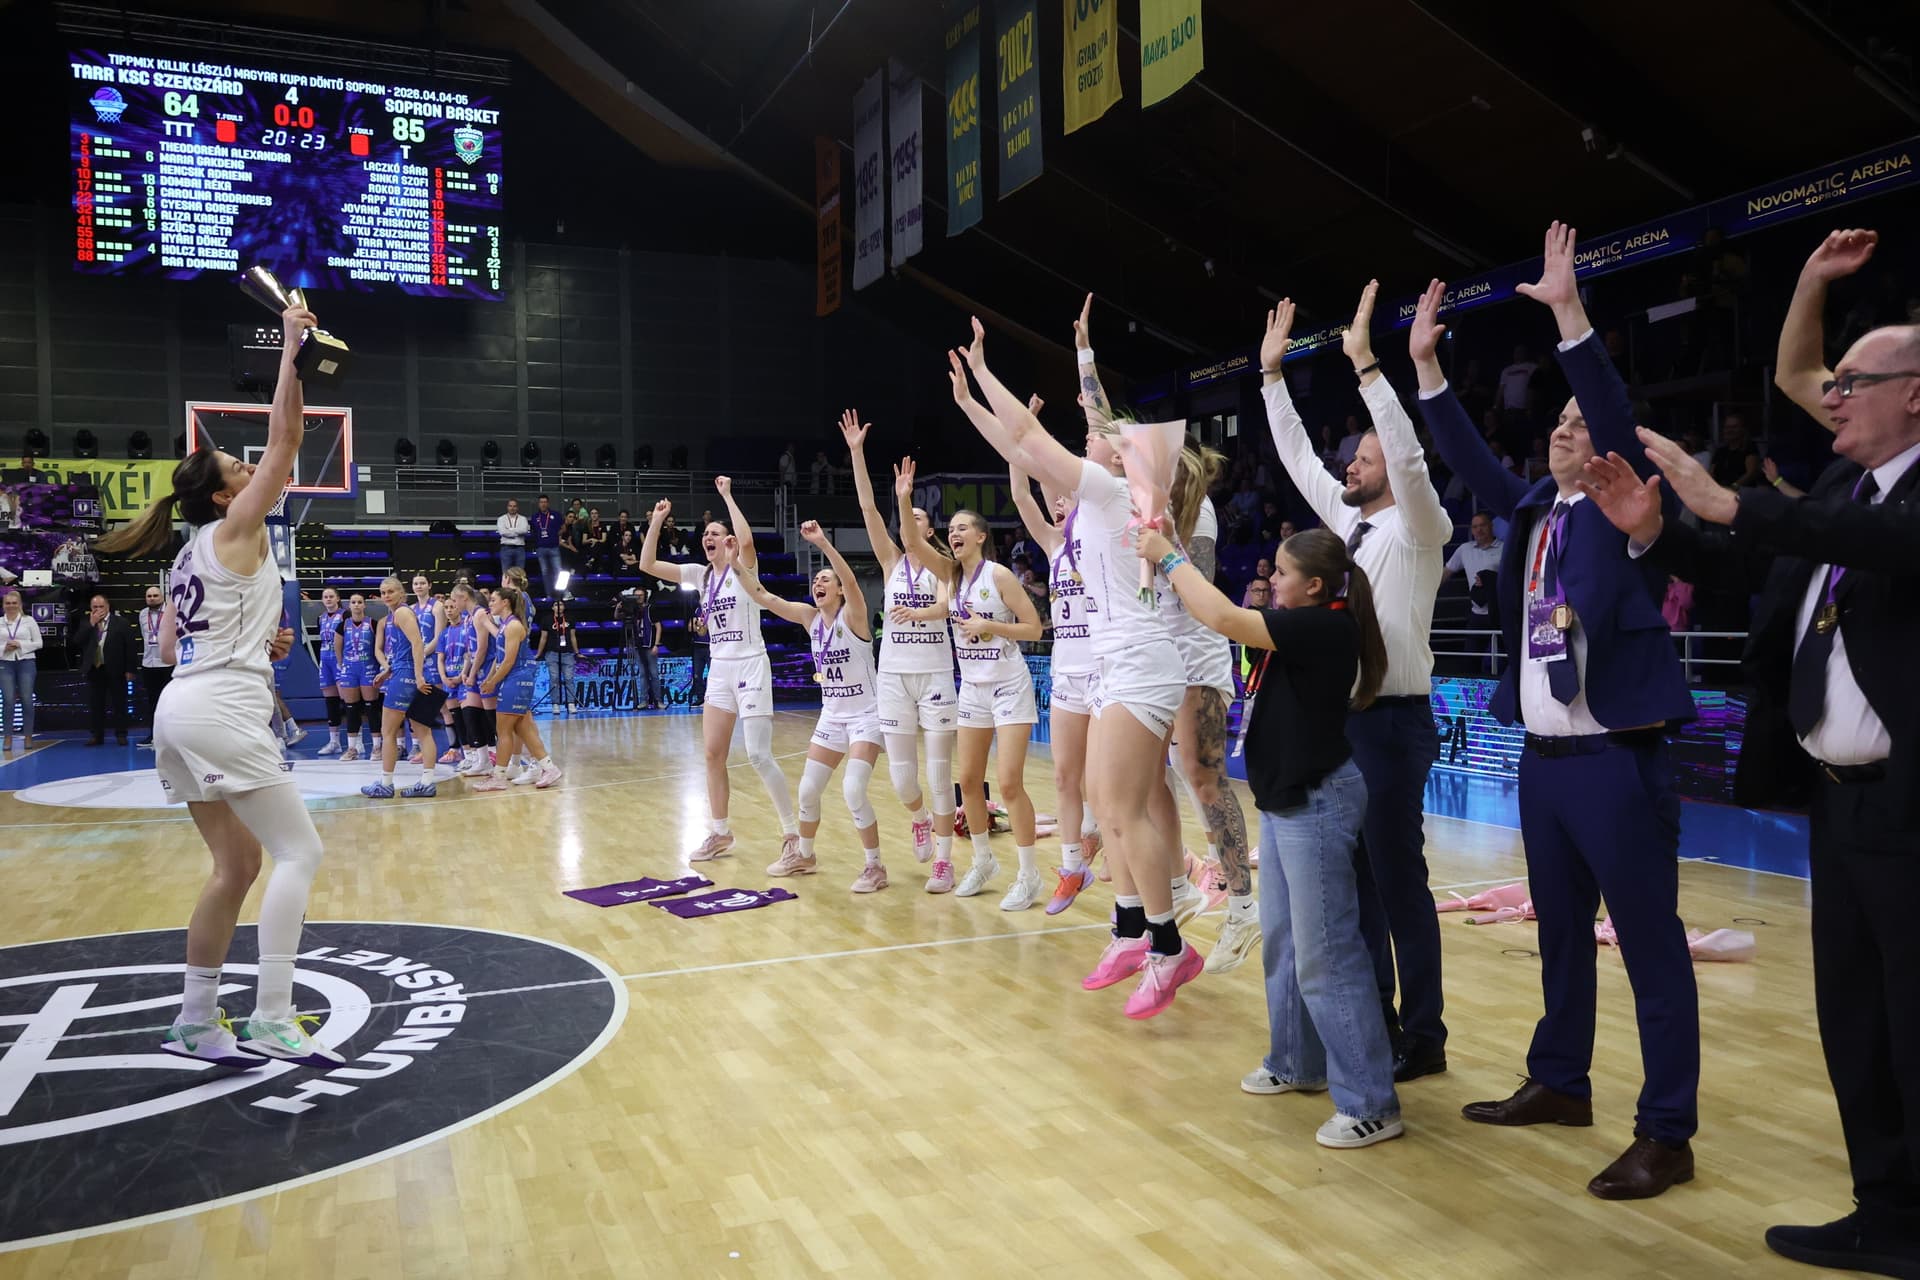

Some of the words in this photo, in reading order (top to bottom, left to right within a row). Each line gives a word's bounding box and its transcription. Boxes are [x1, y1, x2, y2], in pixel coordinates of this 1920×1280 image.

[71, 63, 114, 82] TARR
[119, 69, 149, 86] KSC
[153, 72, 244, 96] SZEKSZÁRD
[108, 53, 154, 69] TIPPMIX
[157, 59, 190, 73] KILLIK
[192, 62, 231, 78] LÁSZLÓ
[234, 68, 278, 83] MAGYAR
[280, 73, 308, 87] KUPA
[310, 76, 343, 91] DÖNTŐ
[345, 81, 385, 96] SOPRON
[164, 91, 199, 118] 64
[285, 86, 299, 105] 4
[274, 104, 314, 129] 0.0
[385, 98, 442, 118] SOPRON
[446, 105, 499, 124] BASKET
[162, 120, 195, 138] TTT
[392, 116, 425, 143] 85
[262, 129, 325, 150] 20:23
[146, 151, 154, 162] 6
[159, 153, 194, 165] MARIA
[231, 148, 291, 163] ALEXANDRA
[400, 145, 411, 160] T
[77, 168, 91, 179] 10
[142, 174, 156, 185] 18
[204, 178, 232, 191] RÉKA
[402, 164, 428, 176] SÁRA
[486, 173, 498, 184] 10
[146, 186, 154, 196] 9
[368, 184, 400, 195] ROKOB
[403, 187, 428, 198] ZORA
[490, 184, 498, 195] 6
[1747, 171, 1845, 215] NOVOMATIC
[1850, 153, 1912, 183] ARÉNA
[146, 197, 155, 208] 6
[361, 194, 386, 204] PAPP
[389, 196, 428, 208] KLAUDIA
[432, 200, 444, 210] 10
[1804, 187, 1847, 206] SOPRON
[142, 208, 156, 220] 16
[350, 214, 374, 226] ZALA
[376, 217, 430, 230] FRISKOVEC
[148, 220, 156, 231] 5
[342, 225, 370, 236] SITKU
[490, 237, 498, 248] 3
[148, 243, 156, 254] 4
[161, 244, 196, 256] HOLCZ
[198, 247, 239, 260] REBEKA
[357, 237, 383, 248] TARA
[386, 240, 430, 252] WALLACK
[491, 248, 498, 258] 6
[1574, 240, 1621, 265] OMATIC
[1624, 228, 1669, 251] ARÉNA
[392, 250, 430, 263] BROOKS
[486, 258, 500, 268] 22
[1591, 254, 1622, 268] SOPRON
[1457, 281, 1491, 300] ARÉNA
[1436, 303, 1456, 314] OPRON
[1288, 330, 1327, 350] OVOMATIC
[1062, 600, 1071, 619] 9
[714, 613, 727, 629] 15
[826, 666, 844, 682] 44
[250, 946, 468, 1114] HUNBASKET
